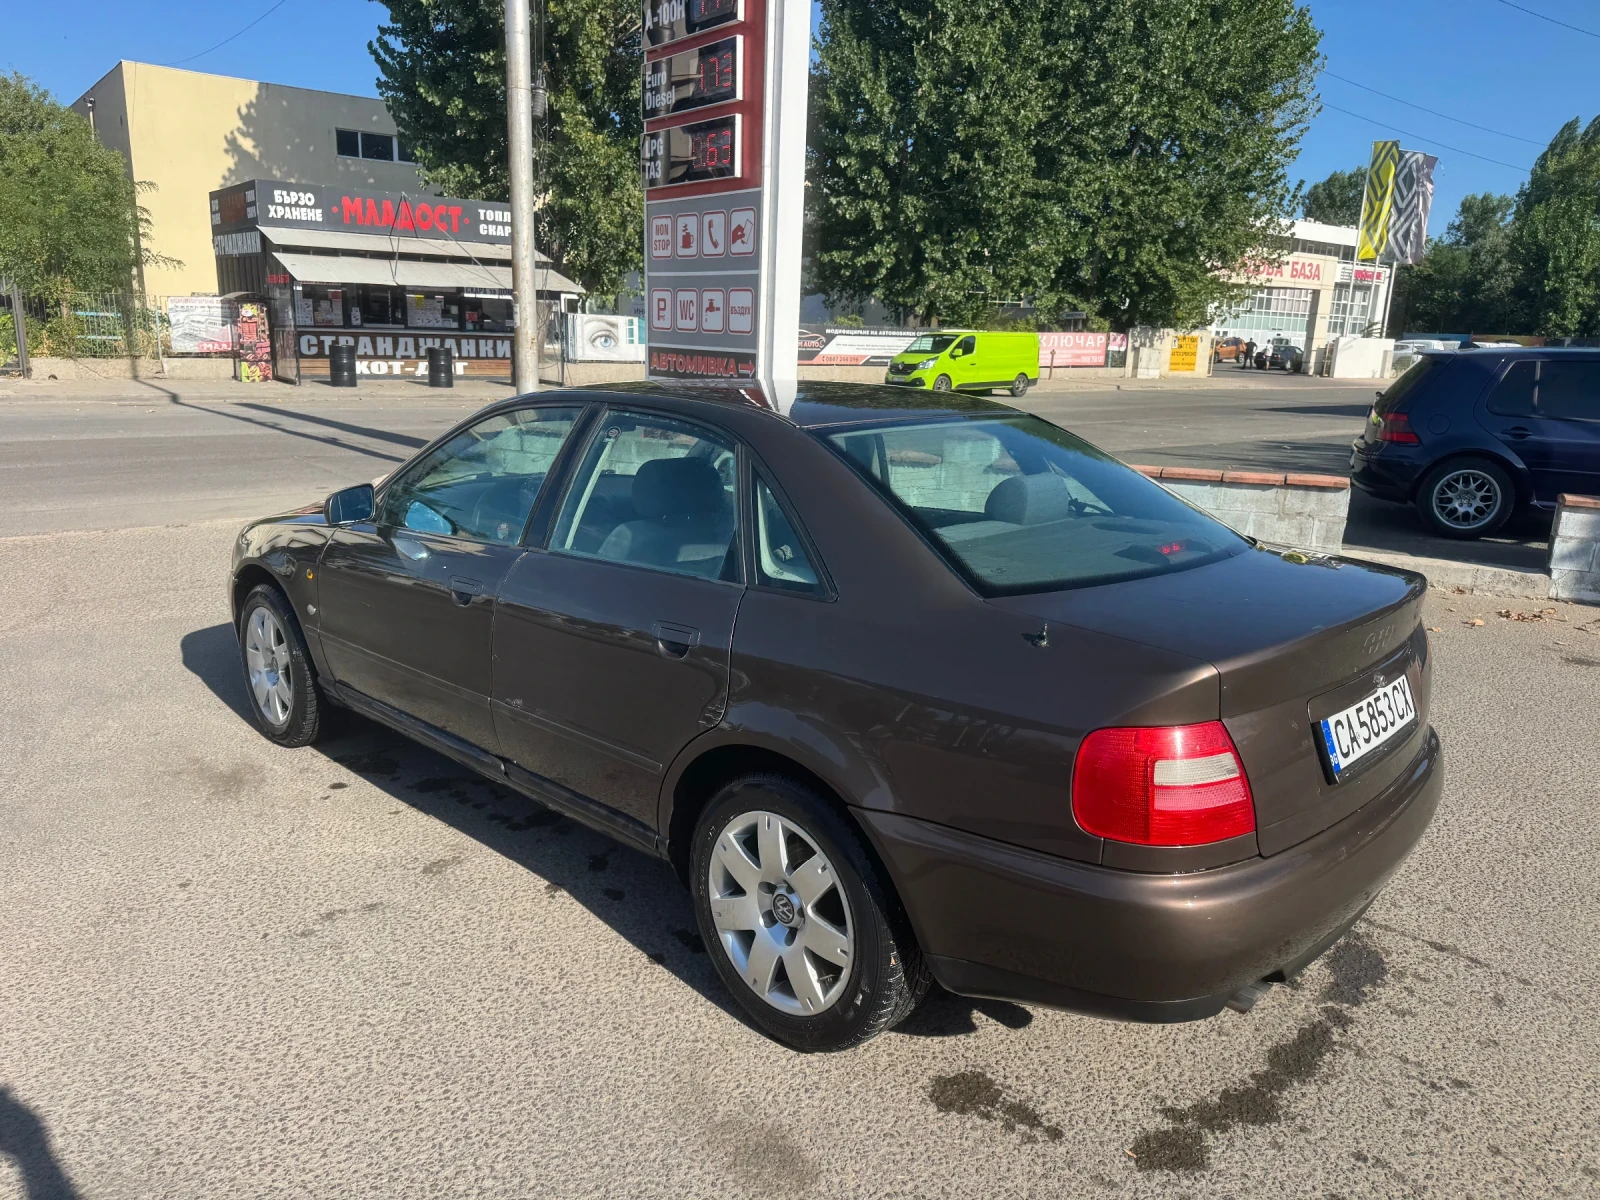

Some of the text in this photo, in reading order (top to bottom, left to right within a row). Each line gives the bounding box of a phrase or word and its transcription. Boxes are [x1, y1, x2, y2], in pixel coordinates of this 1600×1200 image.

[645, 70, 667, 90] Euro
[645, 85, 676, 111] Diesel
[645, 137, 664, 158] LPG
[645, 160, 663, 180] ГАЗ
[273, 190, 315, 206] БЪРЗО
[267, 204, 323, 222] ХРАНЕНЕ
[342, 196, 462, 232] МЛАДОСТ
[478, 208, 512, 223] ТОПЛ
[479, 223, 512, 237] СКАР
[655, 223, 669, 236] NON
[653, 239, 671, 251] STOP
[1290, 261, 1321, 281] БАЗА
[679, 299, 695, 321] WC
[730, 306, 751, 316] ВЪЗДУХ
[300, 335, 511, 358] СТРАНДЖАНКИ
[1040, 336, 1104, 347] КЛЮЧАР
[650, 352, 738, 377] АВТОМИВКА
